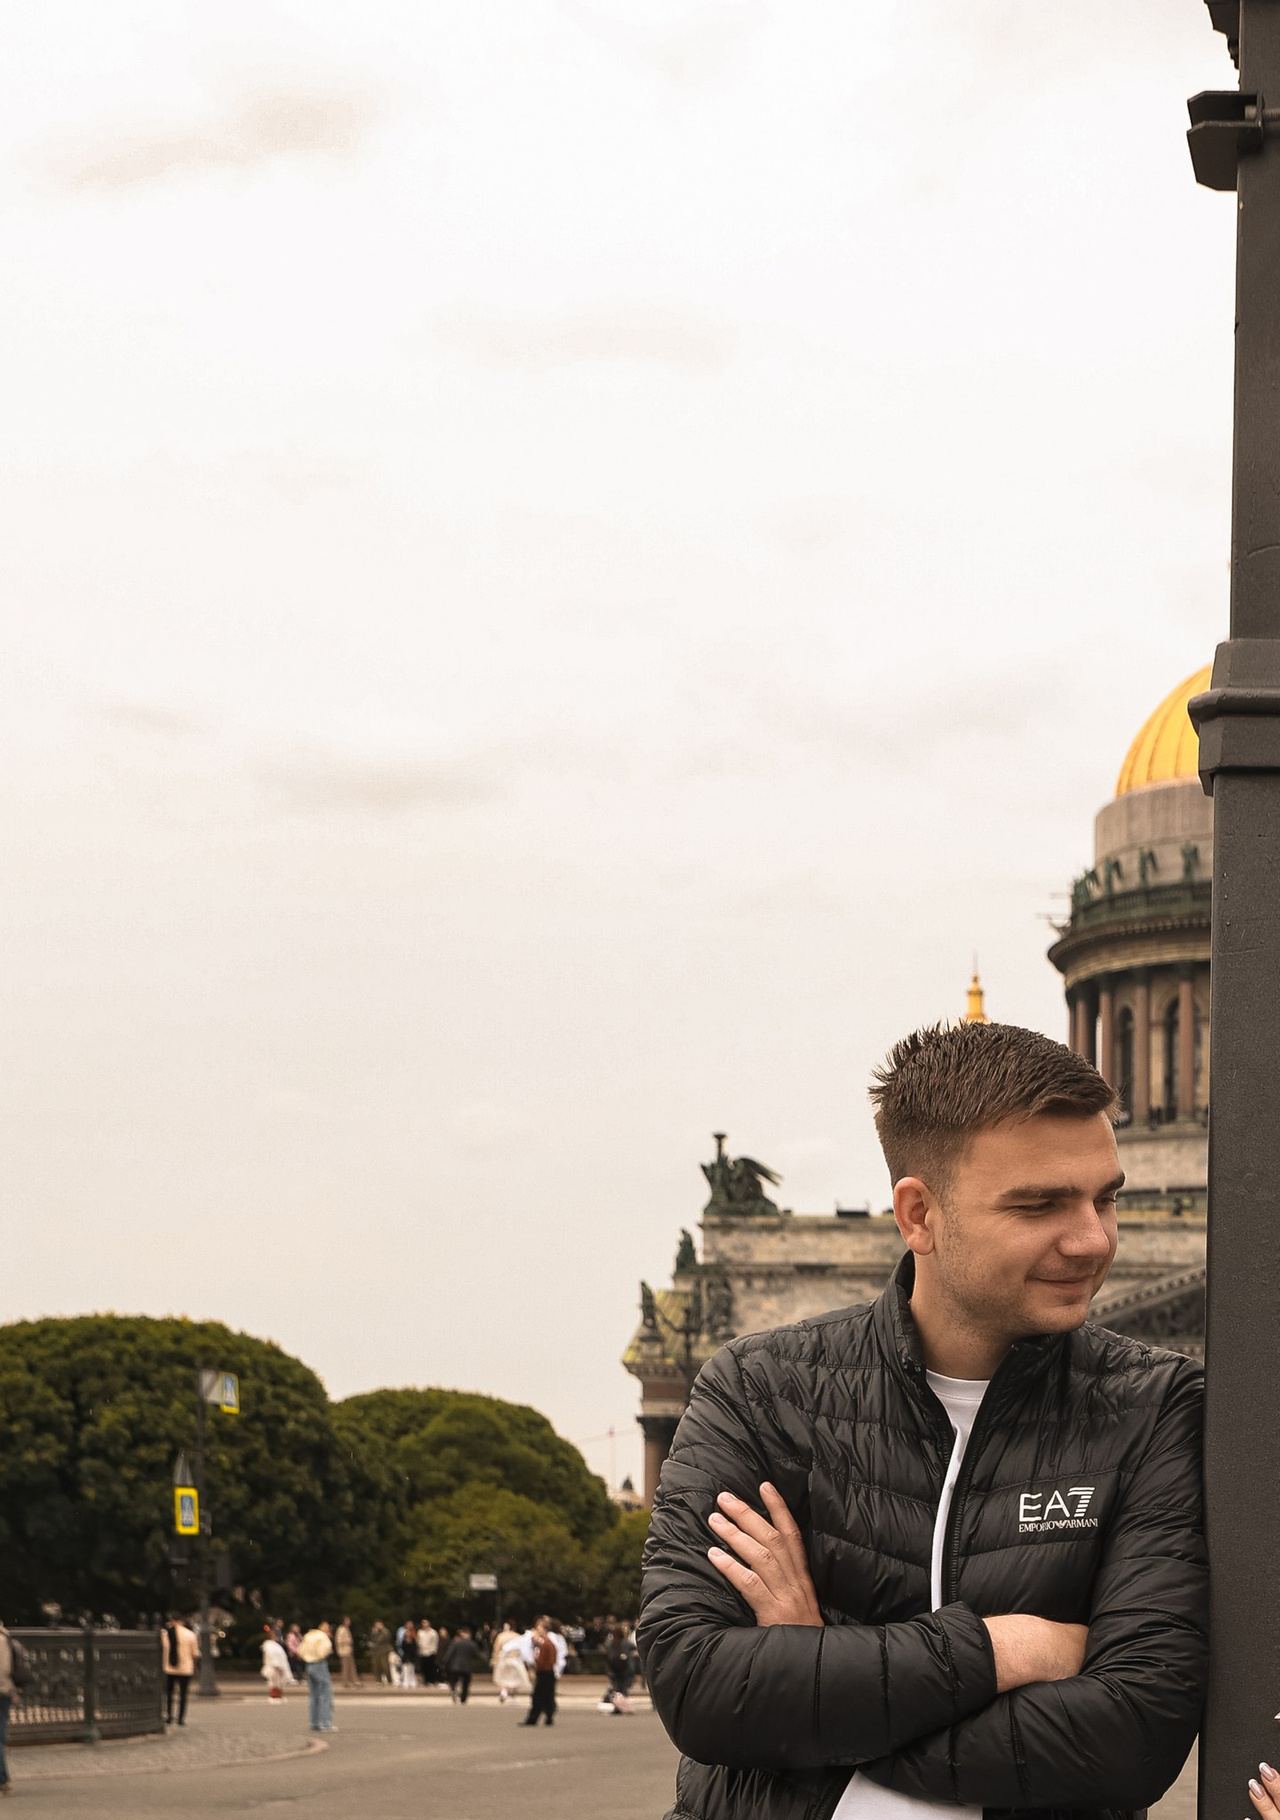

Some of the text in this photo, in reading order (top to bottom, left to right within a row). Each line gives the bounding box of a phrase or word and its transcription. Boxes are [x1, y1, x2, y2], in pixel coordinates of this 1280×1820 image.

[1018, 1487, 1095, 1522] EA7
[1018, 1517, 1098, 1533] EMPORIO ARMANI
